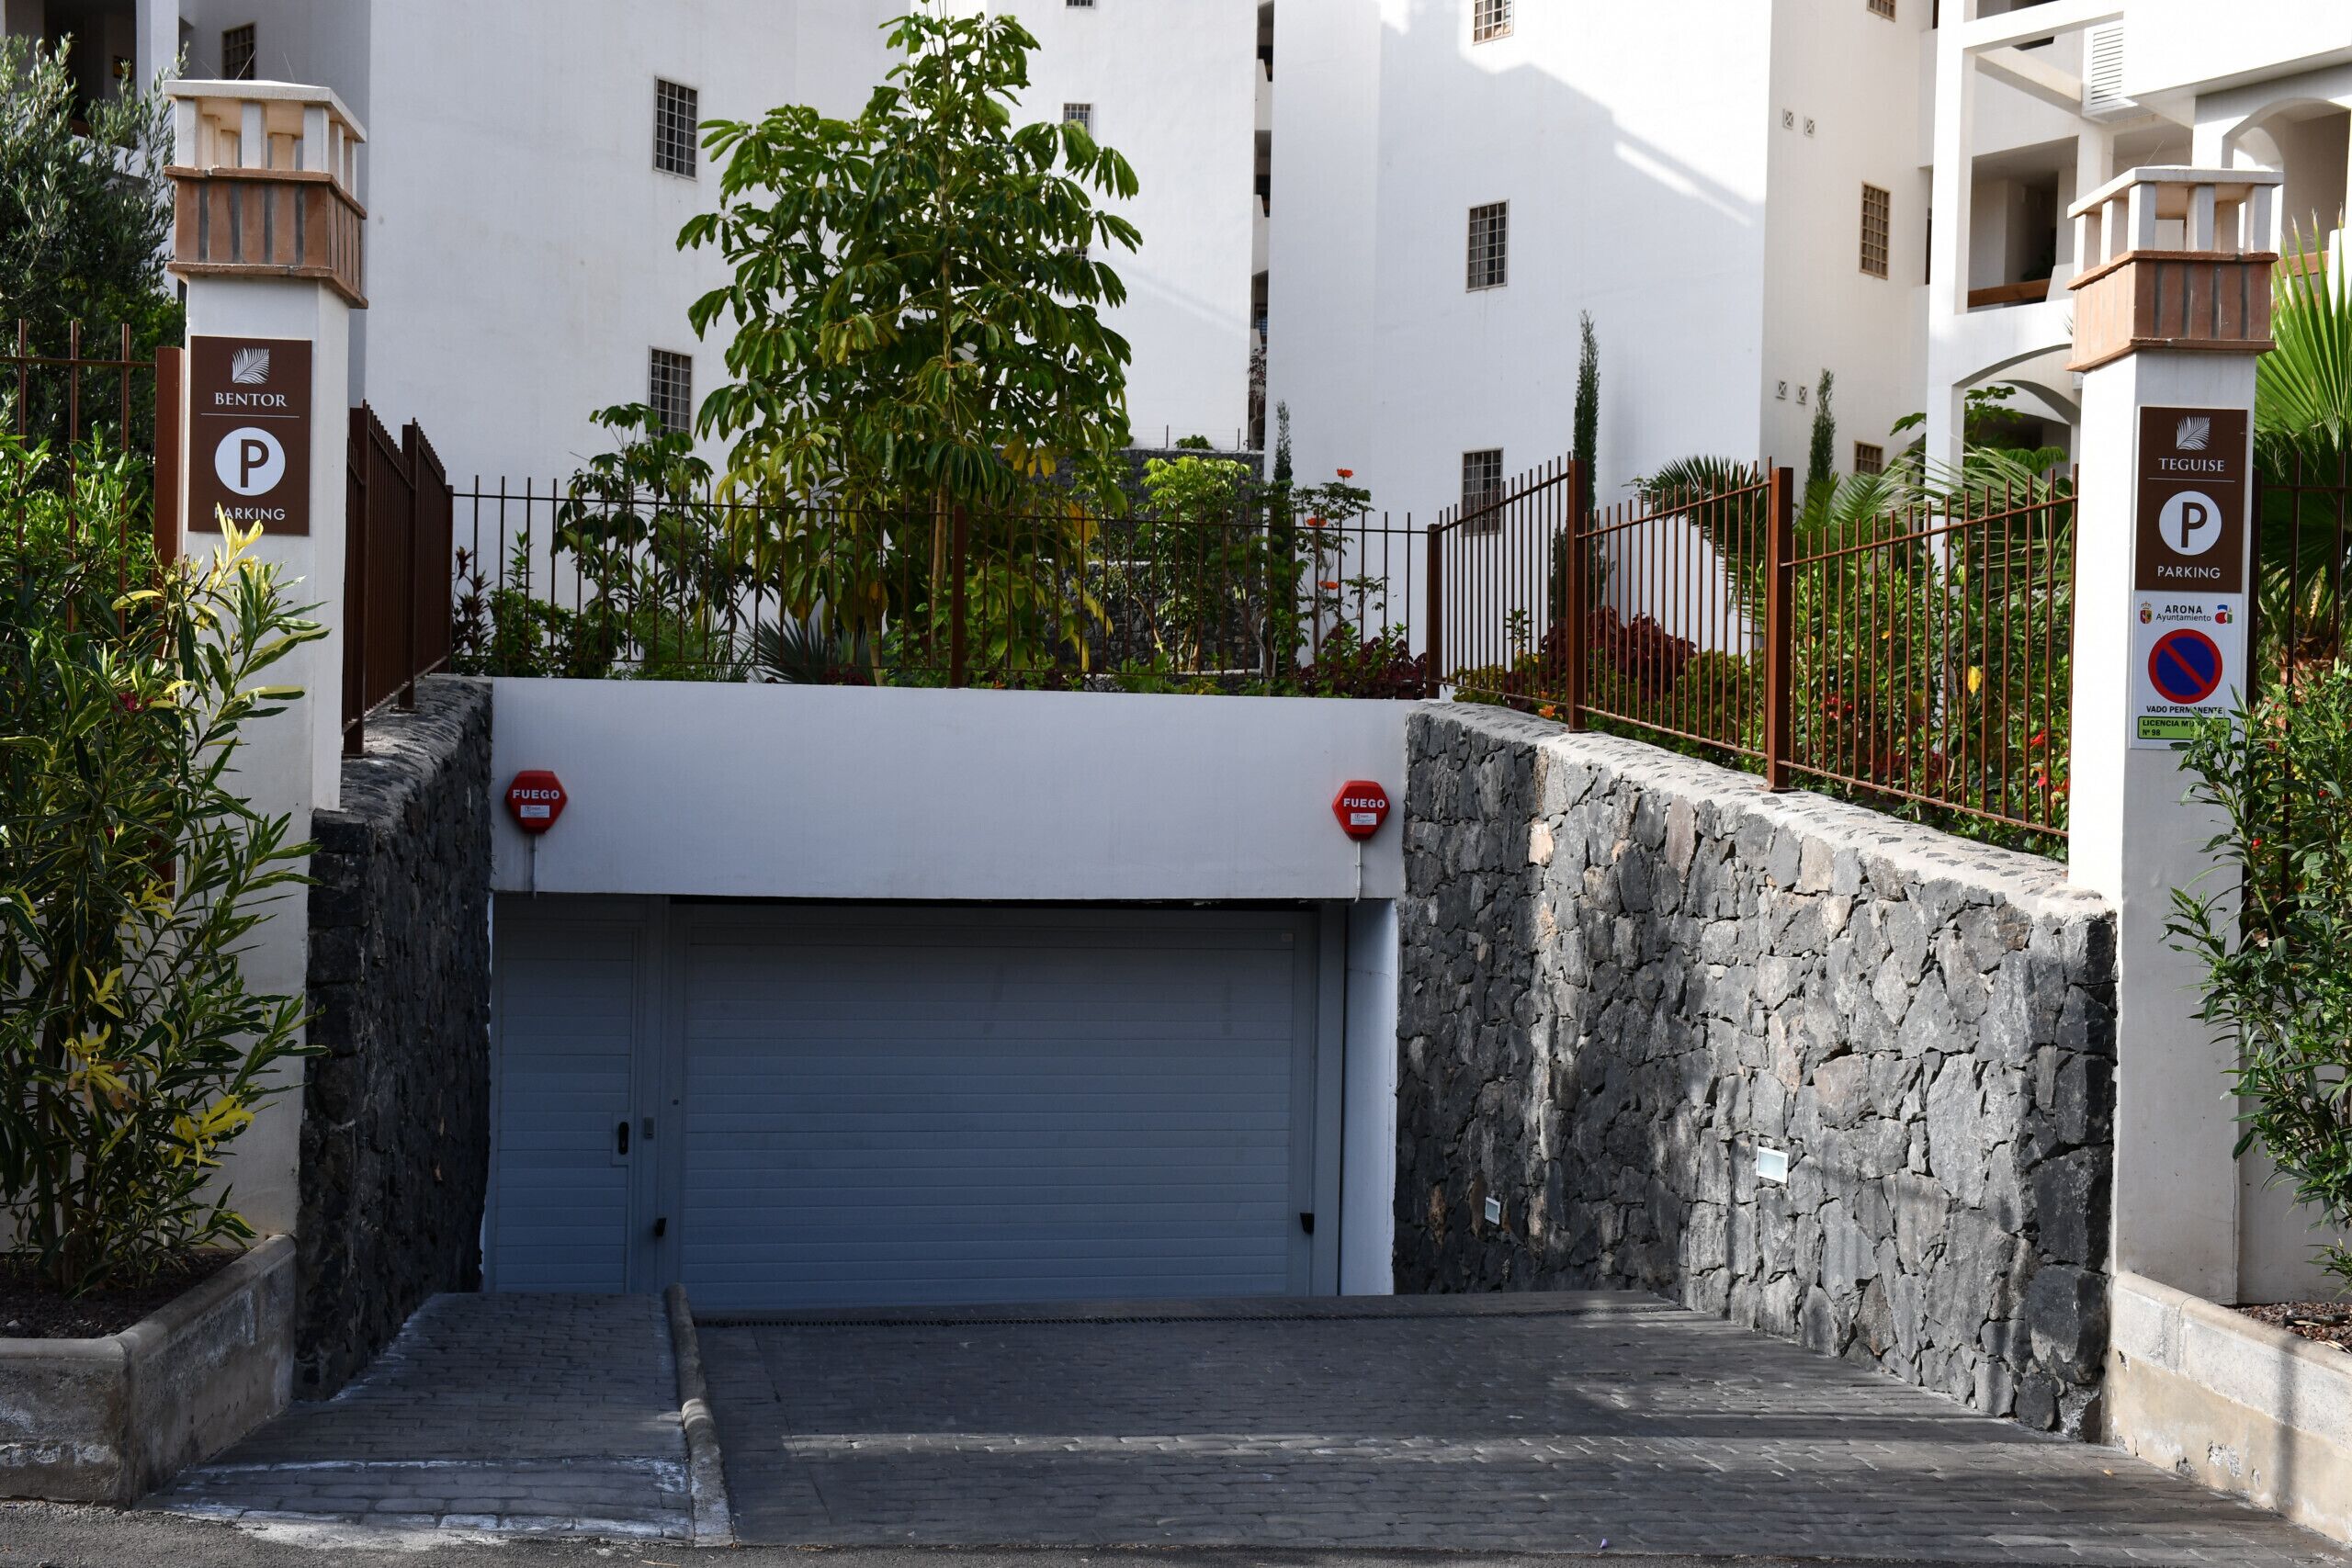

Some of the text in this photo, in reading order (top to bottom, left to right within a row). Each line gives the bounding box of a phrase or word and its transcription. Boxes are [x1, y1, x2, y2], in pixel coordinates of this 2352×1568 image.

[214, 392, 288, 407] BENTOR
[240, 439, 269, 488] P
[2158, 457, 2224, 472] TEGUISE
[2180, 502, 2208, 548] P
[2157, 566, 2221, 579] PARKING
[2165, 604, 2203, 614] ARONA
[2155, 613, 2211, 622] Ayuntamiento
[2143, 719, 2179, 728] LICENCIA
[512, 789, 560, 800] FUEGO
[1343, 797, 1385, 808] FUEGO
